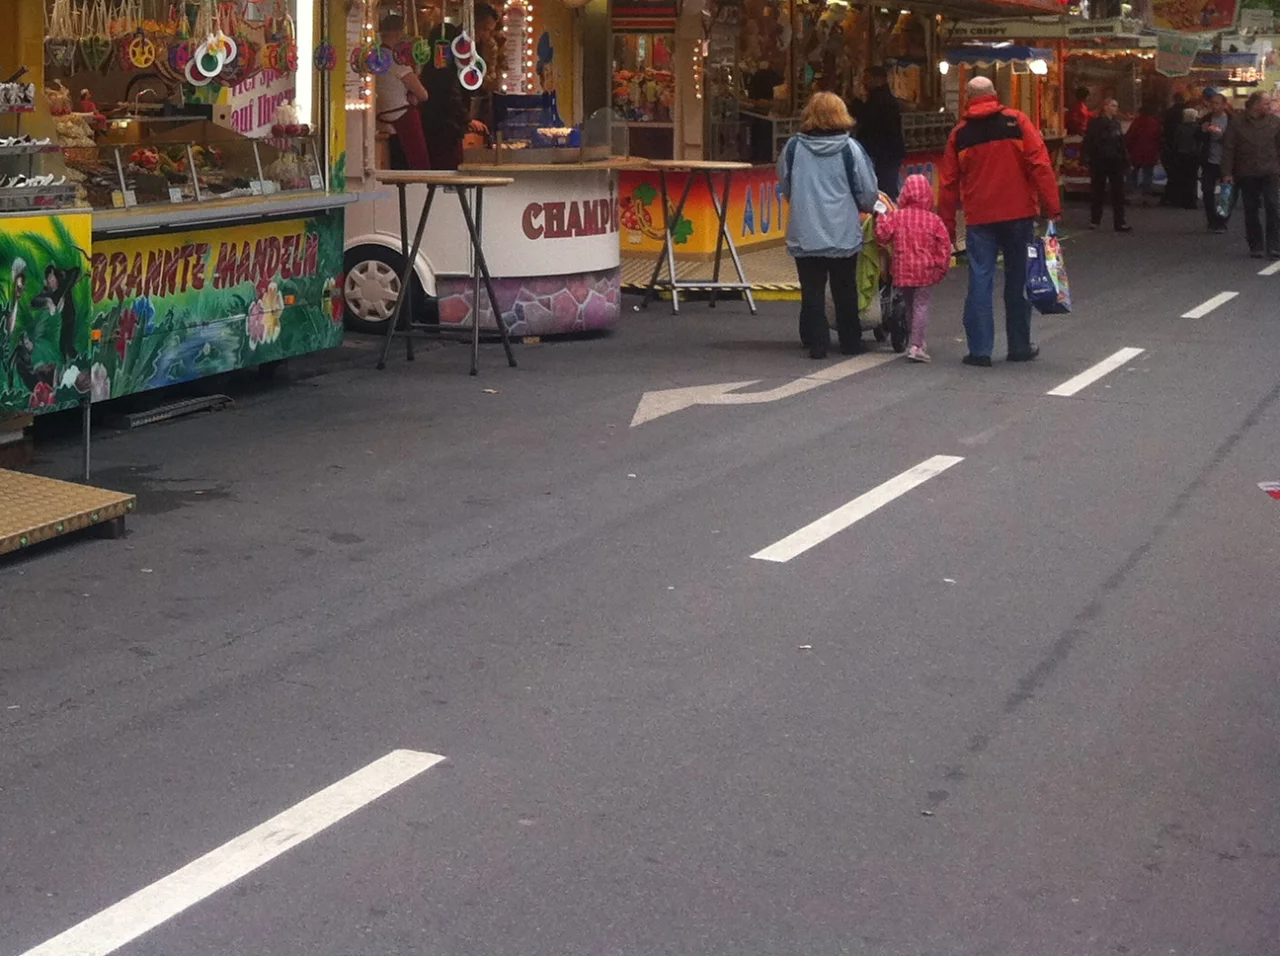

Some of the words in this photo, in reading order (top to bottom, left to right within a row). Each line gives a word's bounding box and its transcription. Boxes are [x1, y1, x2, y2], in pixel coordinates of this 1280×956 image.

[231, 99, 254, 133] auf
[92, 242, 211, 303] BRANNTE
[213, 231, 320, 290] MANDELN
